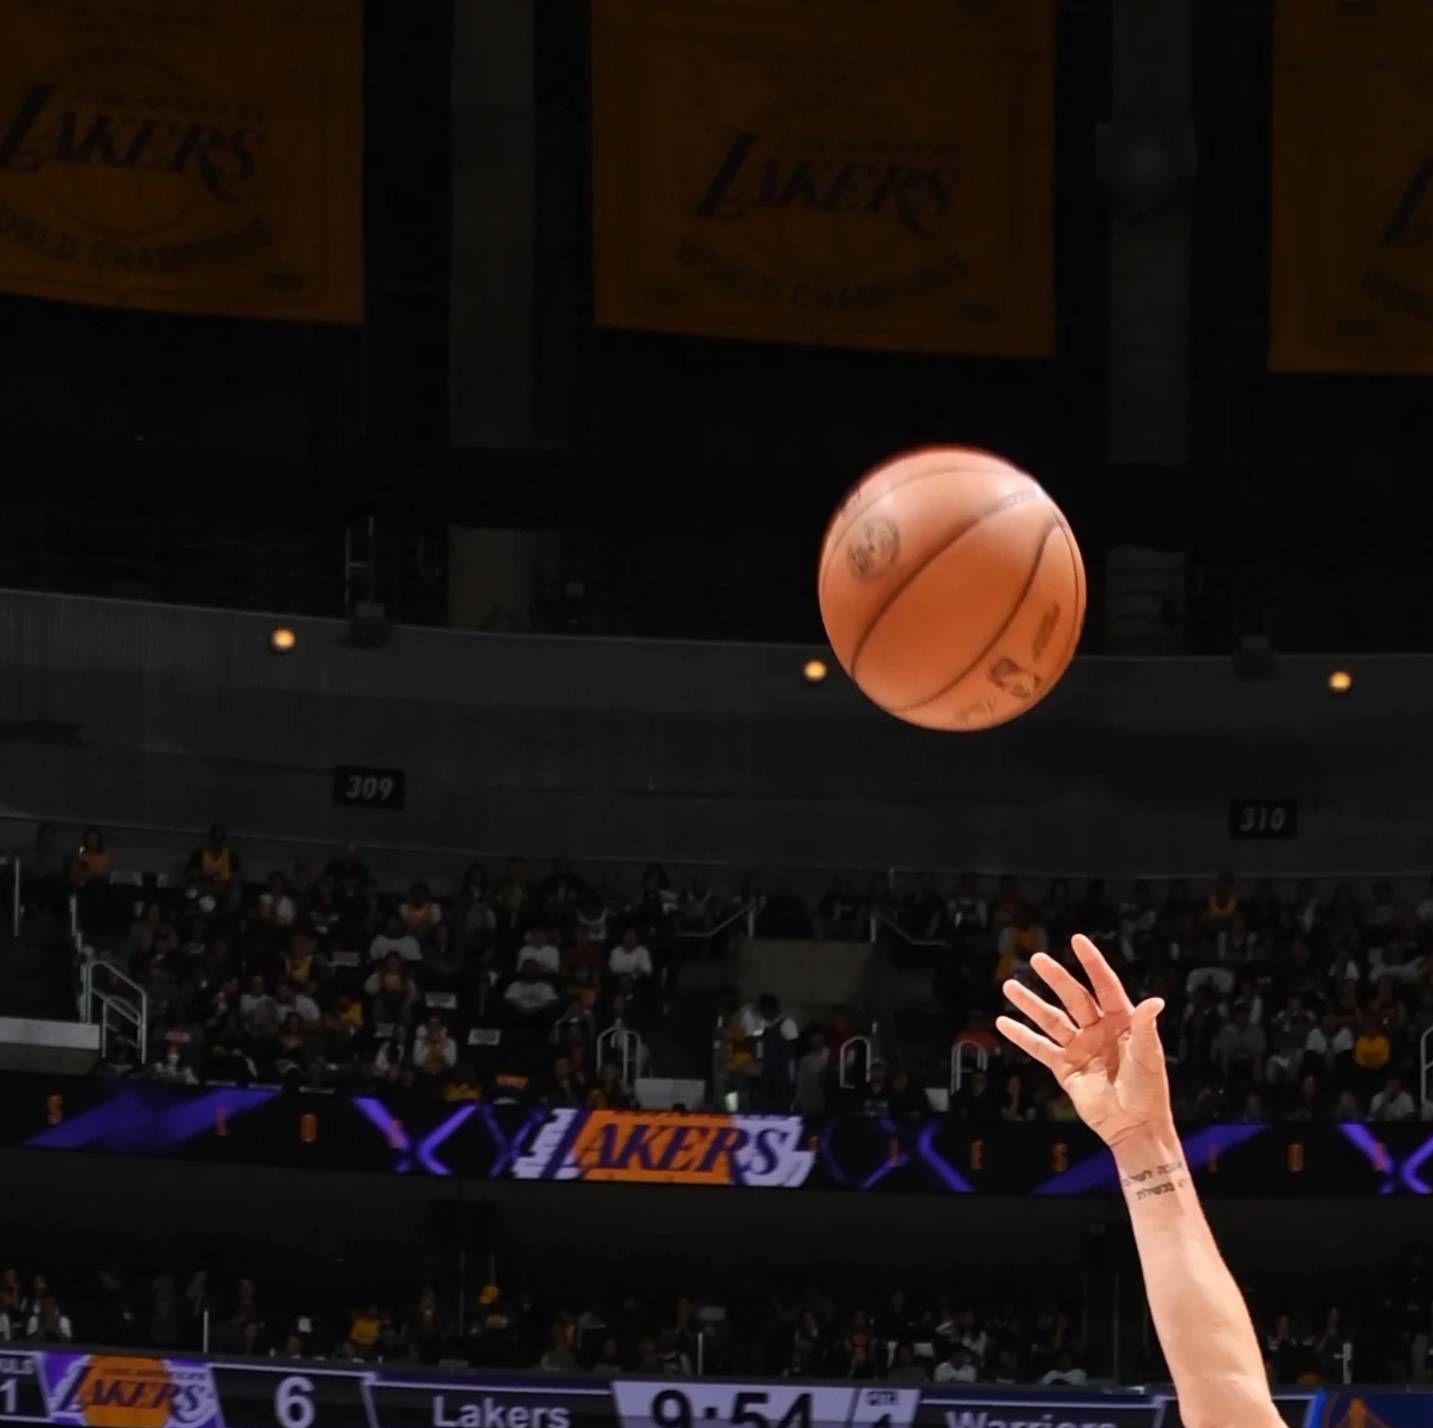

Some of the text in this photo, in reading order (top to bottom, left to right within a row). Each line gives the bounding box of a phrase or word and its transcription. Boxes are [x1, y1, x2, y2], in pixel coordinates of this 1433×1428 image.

[344, 774, 394, 802] 309
[1239, 805, 1287, 834] 310
[538, 1104, 790, 1188] LAKERS
